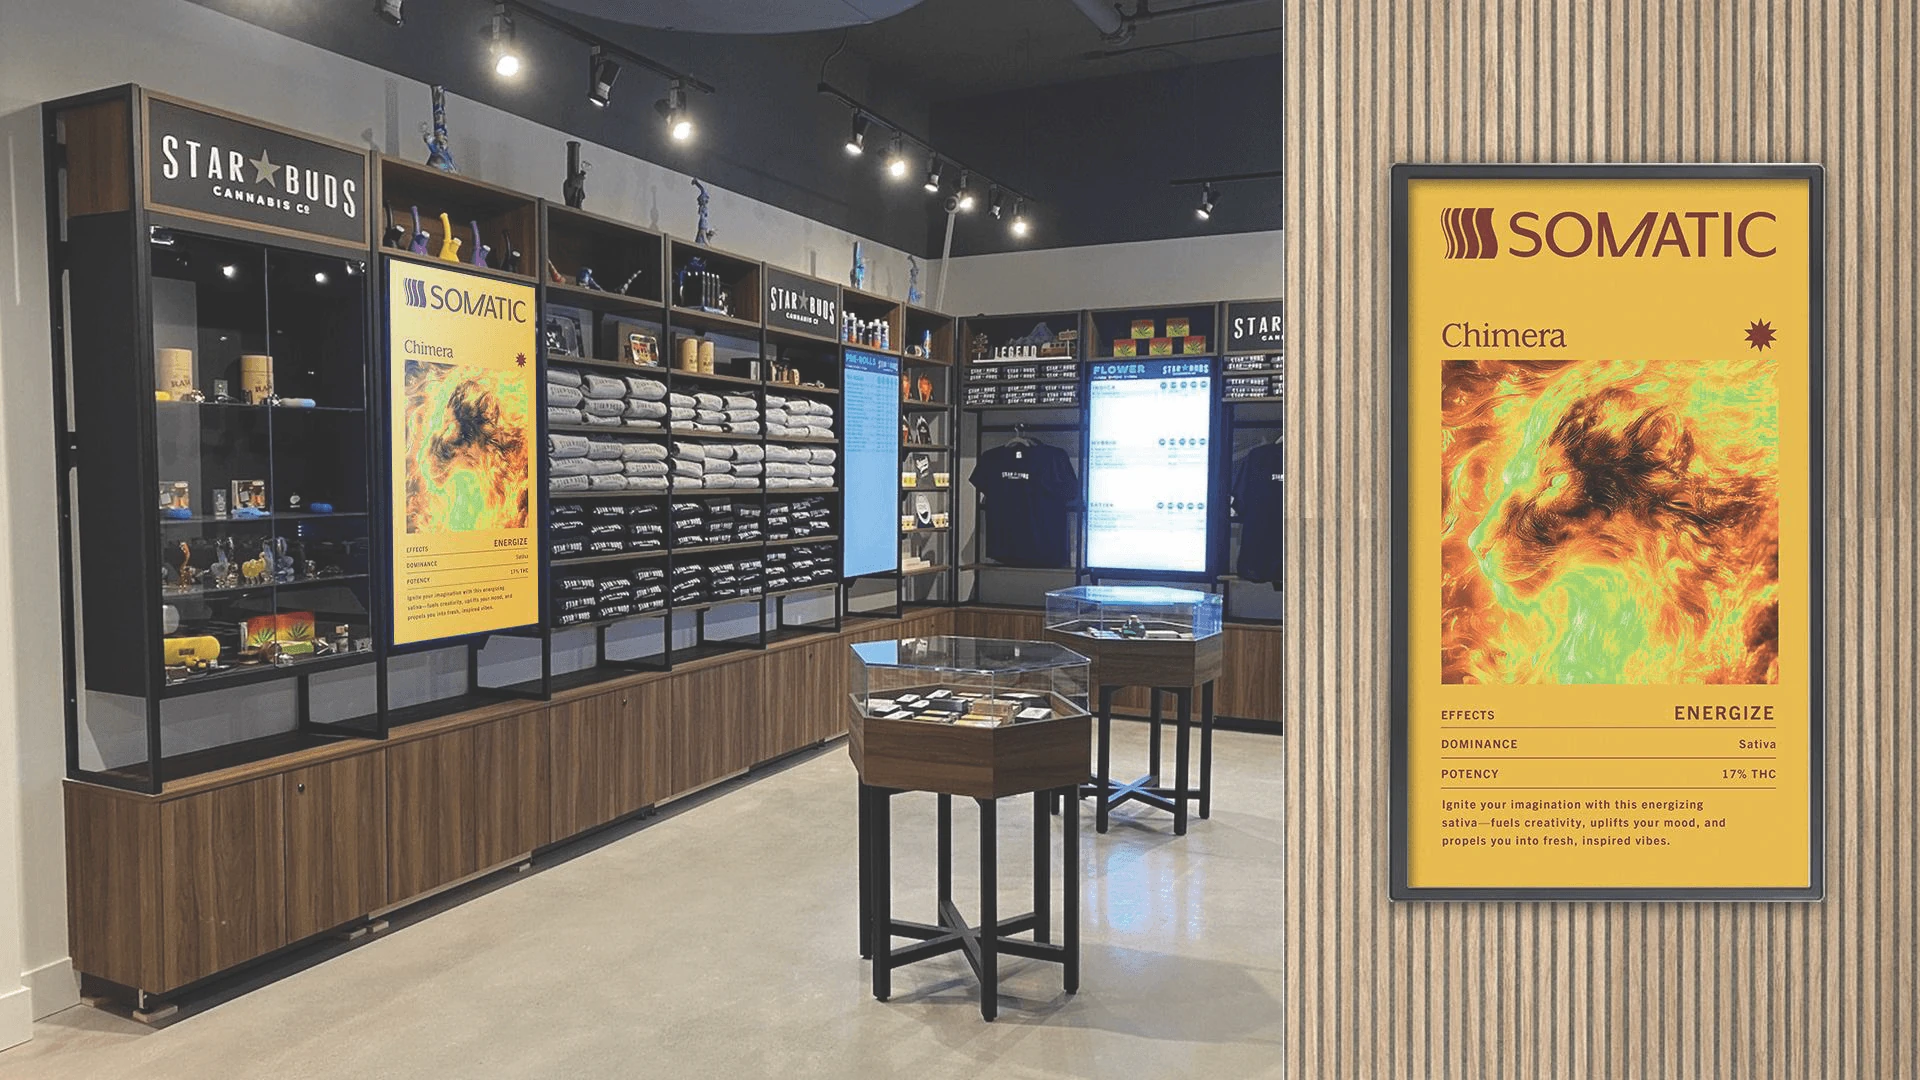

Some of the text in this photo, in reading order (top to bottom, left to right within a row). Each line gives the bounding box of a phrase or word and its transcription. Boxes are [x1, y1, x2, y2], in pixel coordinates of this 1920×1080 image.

[163, 135, 355, 218] STAR BUDS
[213, 186, 290, 211] CANNABIS
[1509, 212, 1776, 258] SOMATIC
[431, 285, 526, 323] SOMATIC
[771, 287, 834, 324] STAR BUDS
[1234, 316, 1281, 339] STAR
[1442, 322, 1567, 350] Chimera
[405, 339, 453, 358] Chimera
[995, 345, 1036, 360] LEGEND
[1093, 364, 1145, 374] FLOWER
[494, 538, 528, 547] ENERGIZE
[1442, 706, 1774, 720] EFFECTS ENERGIZE
[1442, 737, 1776, 750] DOMINANCE Sativa
[1442, 769, 1776, 781] POTENCY 17% THC
[1443, 800, 1704, 813] Ignite your imagination with this energizing
[1524, 817, 1585, 831] creativity,
[1591, 816, 1631, 831] uplifts
[1633, 820, 1659, 831] your
[1664, 818, 1699, 828] mood,
[1704, 818, 1725, 828] and
[1440, 835, 1671, 848] propels you into fresh, inspired vibes.
